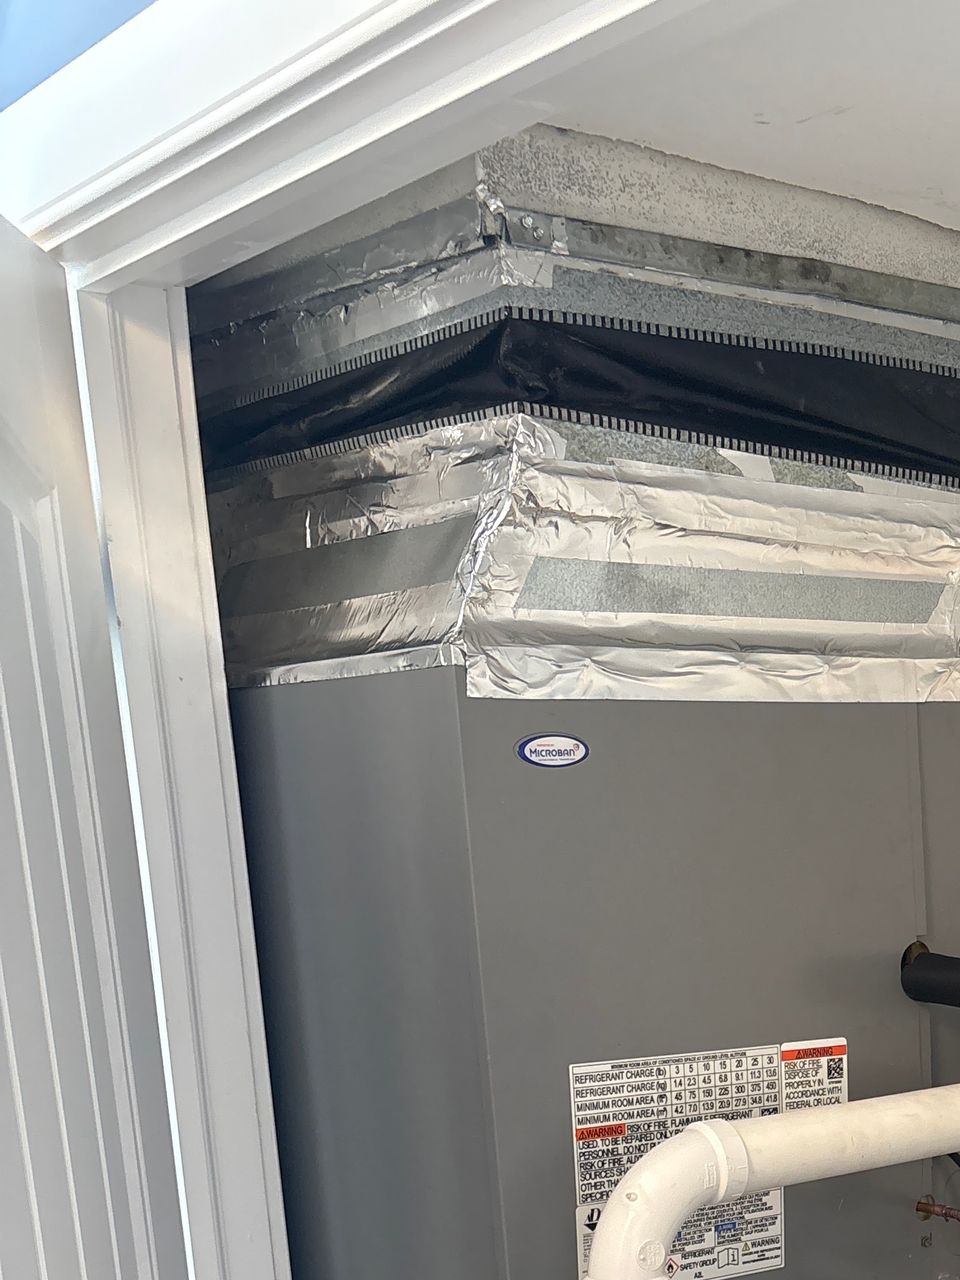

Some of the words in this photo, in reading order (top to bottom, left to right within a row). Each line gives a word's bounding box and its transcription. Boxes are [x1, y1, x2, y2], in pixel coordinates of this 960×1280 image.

[801, 1047, 832, 1058] WARNING
[575, 1072, 624, 1084] REFRIGERANT
[626, 1068, 654, 1080] CHARGE
[675, 1066, 679, 1074] 3
[689, 1064, 693, 1073] 5
[703, 1063, 710, 1071] 10
[720, 1061, 727, 1069] 15
[736, 1060, 743, 1068] 20
[752, 1058, 759, 1066] 25
[767, 1056, 774, 1064] 30
[785, 1069, 810, 1080] DISPOSE
[576, 1085, 625, 1098] REFRIGERANT
[626, 1082, 655, 1093] CHARGE
[674, 1079, 682, 1088] 1.4
[687, 1078, 696, 1086] 2.3
[702, 1076, 711, 1084] 4.5
[719, 1074, 728, 1082] 6.8
[735, 1073, 743, 1081] 9.1
[751, 1071, 761, 1079] 11.3
[766, 1069, 776, 1077] 13.6
[785, 1079, 817, 1090] PROPERLY
[818, 1078, 823, 1086] IN
[577, 1102, 610, 1112] MINIMUM
[612, 1098, 634, 1109] ROOM
[636, 1096, 654, 1105] AREA
[688, 1091, 696, 1099] 75
[702, 1089, 713, 1098] 150
[719, 1087, 729, 1095] 225
[750, 1084, 761, 1092] 375
[766, 1082, 776, 1090] 450
[785, 1088, 826, 1100] ACCORDANCE
[827, 1086, 842, 1094] WITH
[786, 1100, 812, 1110] FEDERAL
[823, 1096, 841, 1105] LOCAL
[577, 1115, 610, 1126] MINIMUM
[612, 1112, 634, 1121] ROOM
[636, 1109, 654, 1119] AREA
[674, 1106, 684, 1114] 4.2
[689, 1104, 698, 1113] 7.0
[702, 1102, 714, 1111] 13.9
[718, 1100, 730, 1109] 20.9
[734, 1098, 746, 1107] 27.9
[750, 1096, 762, 1105] 34.8
[766, 1094, 777, 1103] 41.8
[586, 1126, 623, 1137] WARNING
[627, 1124, 642, 1133] RISK
[643, 1123, 653, 1131] OF
[579, 1140, 598, 1150] USED.
[601, 1138, 610, 1147] TO
[611, 1137, 621, 1146] BE
[622, 1133, 655, 1144] REPAIRED
[656, 1129, 673, 1140] ONLY
[623, 1146, 634, 1154] DO
[635, 1143, 648, 1153] NOT
[580, 1161, 596, 1170] RISK
[597, 1160, 607, 1169] OF
[580, 1170, 615, 1181] SOURCES
[581, 1180, 605, 1192] OTHER
[751, 1237, 780, 1248] WARNING
[681, 1248, 715, 1260] REFRIGERANT
[680, 1261, 699, 1271] SAFETY
[700, 1258, 717, 1267] GROUP
